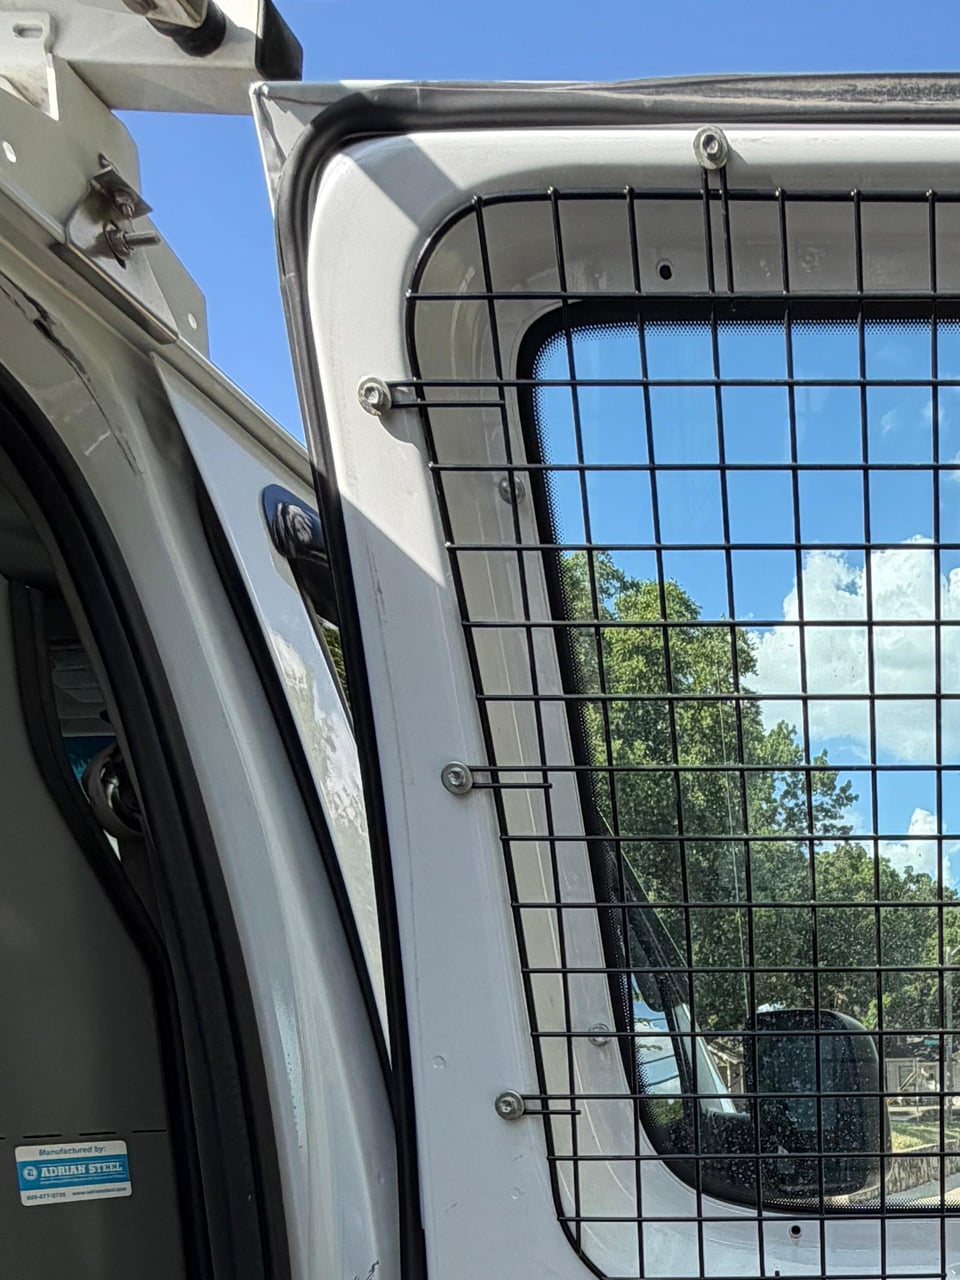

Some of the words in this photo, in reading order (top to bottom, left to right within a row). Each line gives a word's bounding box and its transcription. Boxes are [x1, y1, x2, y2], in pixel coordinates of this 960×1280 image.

[39, 1146, 92, 1156] Manufactured
[94, 1145, 106, 1154] by:
[41, 1165, 86, 1177] ADRIAN
[89, 1162, 123, 1174] STEEL
